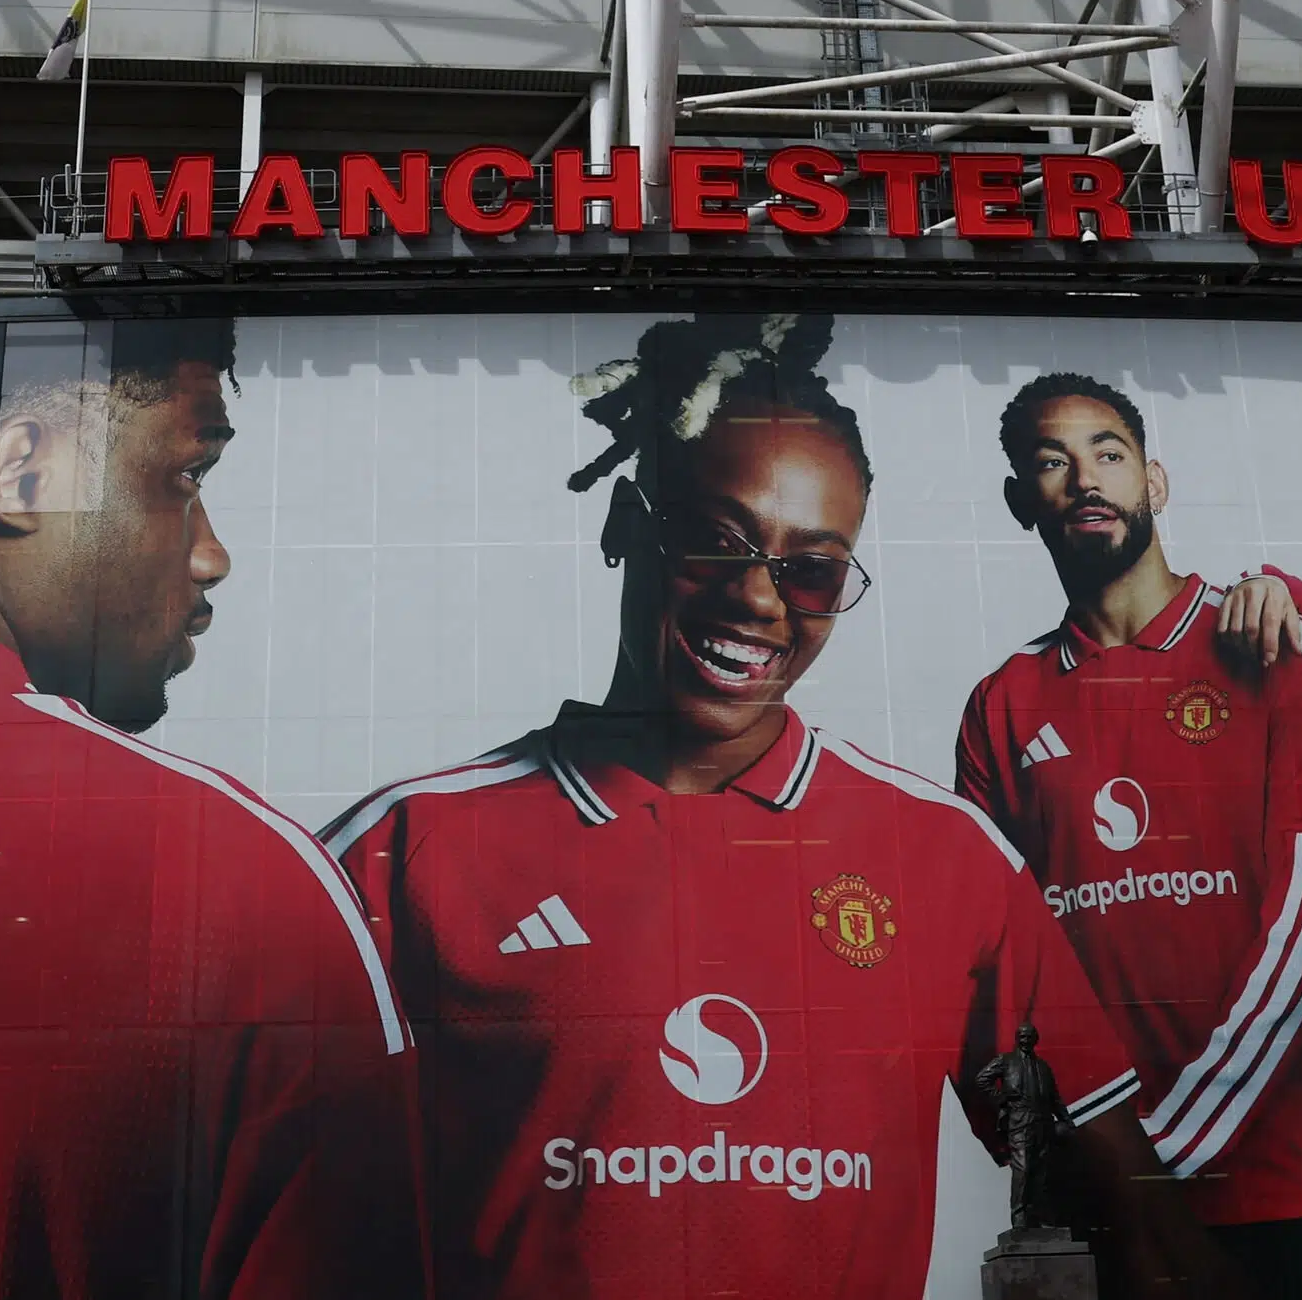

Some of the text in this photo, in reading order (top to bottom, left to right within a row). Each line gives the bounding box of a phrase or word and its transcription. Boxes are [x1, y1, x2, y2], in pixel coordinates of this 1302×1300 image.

[104, 146, 1132, 241] MANCHESTER
[1044, 867, 1238, 919] Snapdragon
[544, 1131, 871, 1201] Snapdragon
